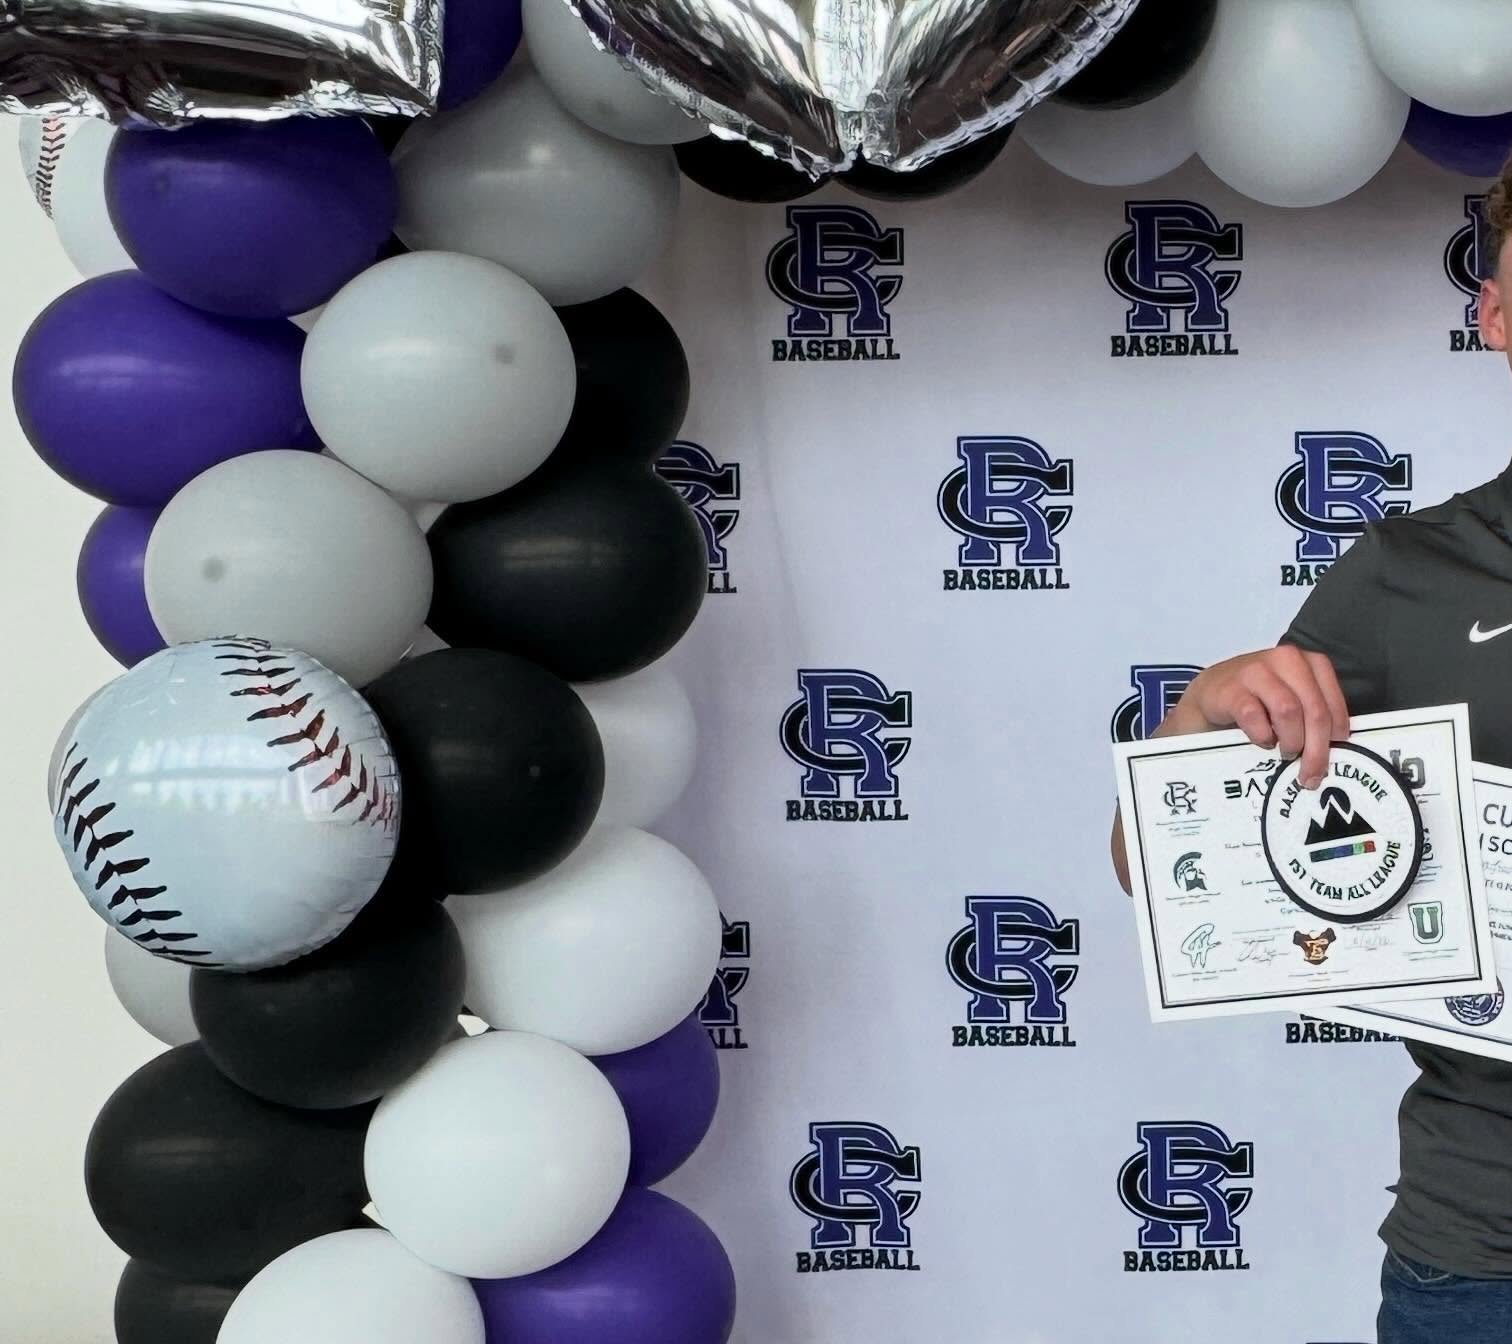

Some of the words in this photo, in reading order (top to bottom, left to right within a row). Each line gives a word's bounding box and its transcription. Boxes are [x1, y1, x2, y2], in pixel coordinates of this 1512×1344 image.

[772, 339, 900, 361] BASEBALL
[1111, 334, 1239, 356] BASEBALL
[943, 568, 1070, 590] BASEBALL
[786, 800, 909, 822] BASEBALL
[952, 1025, 1076, 1047] BASEBALL
[796, 1250, 921, 1272] BASEBALL
[1124, 1250, 1250, 1272] BASEBALL
